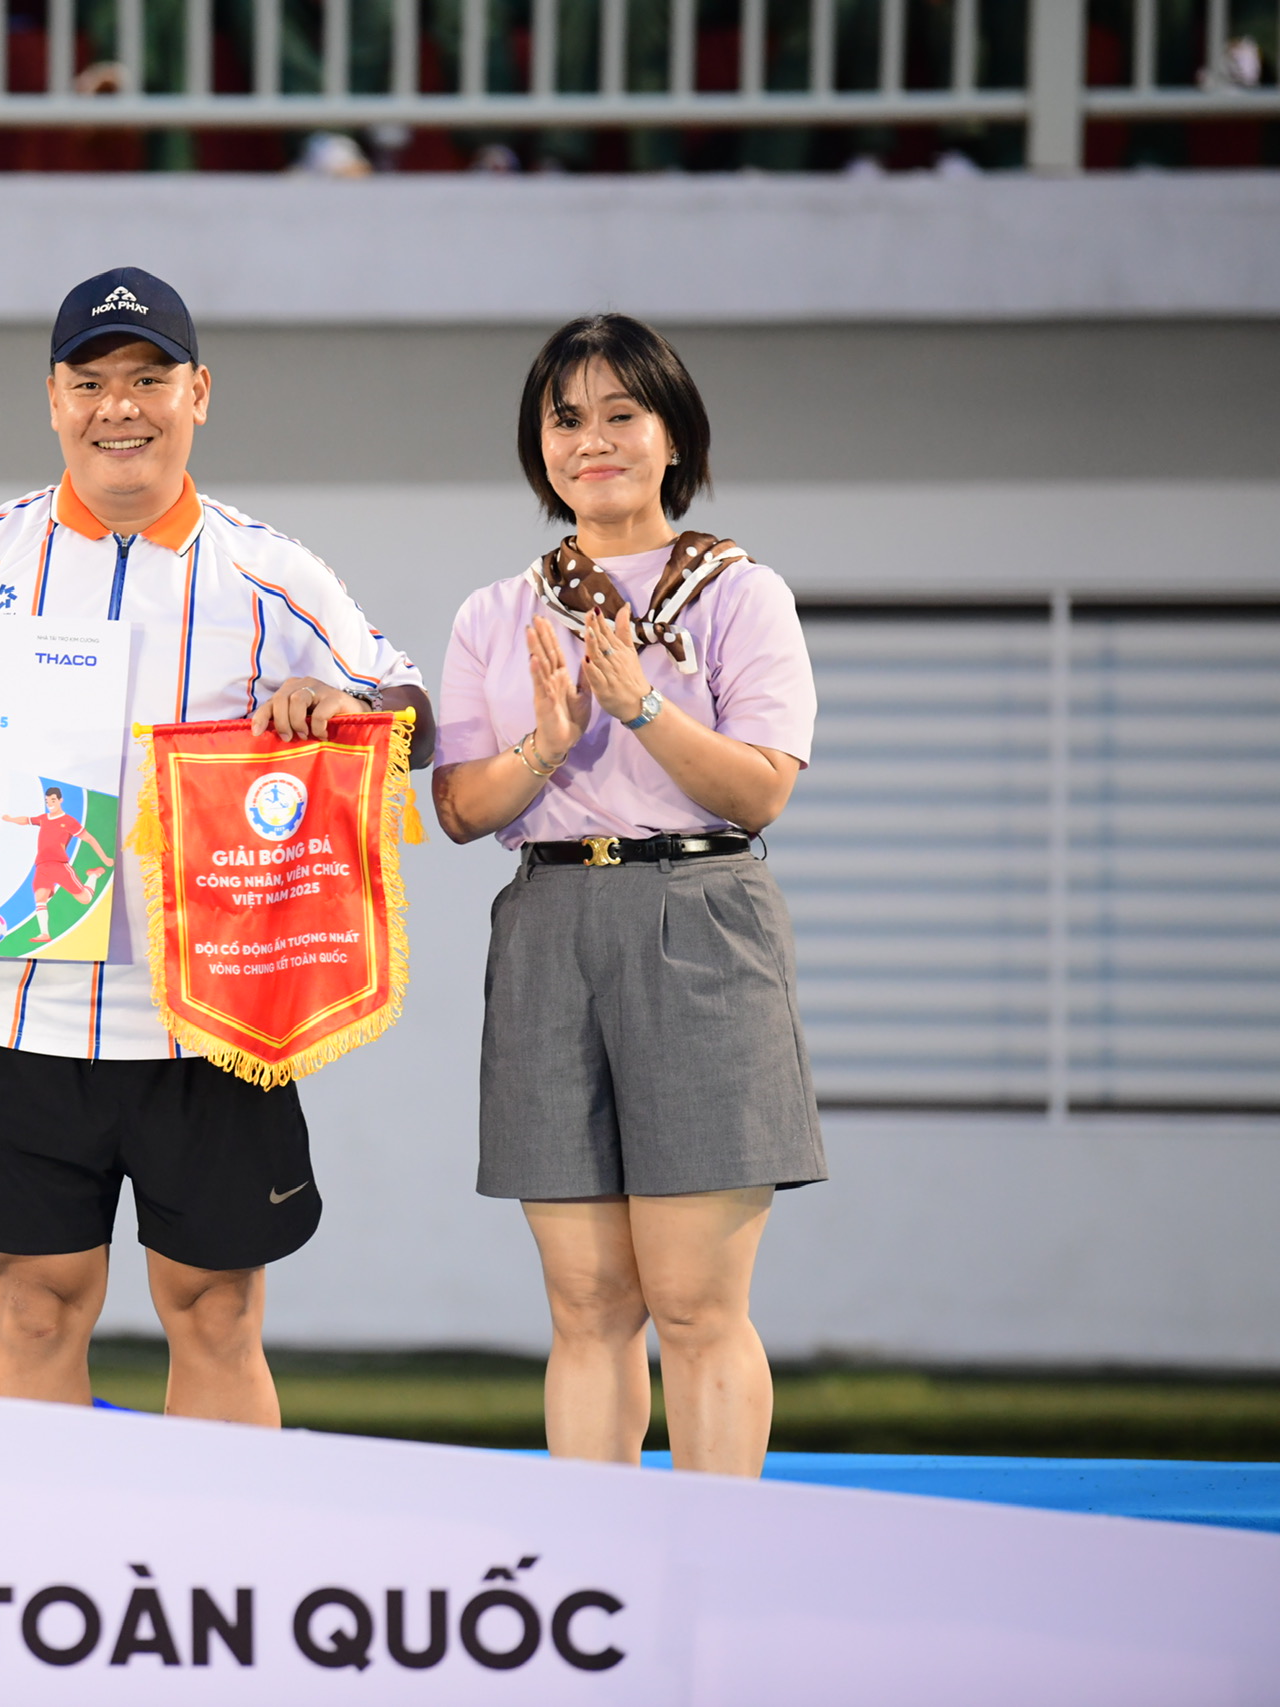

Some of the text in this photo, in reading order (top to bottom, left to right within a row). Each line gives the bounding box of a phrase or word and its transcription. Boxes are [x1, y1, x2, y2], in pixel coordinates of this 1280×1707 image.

[34, 652, 98, 667] THACO
[212, 834, 333, 866] GIẢI BÓNG ĐÁ
[196, 861, 350, 888] CÔNG NHÂN, VIÊN CHỨC
[232, 882, 320, 909] VIỆT NAM 2025
[194, 942, 218, 958] ĐỘI
[242, 942, 272, 958] ĐỘNG
[274, 937, 286, 952] ẤN
[288, 932, 328, 948] TƯỢNG
[329, 930, 360, 943] NHẤT
[208, 948, 348, 975] VÒNG CHUNG KẾT TOÀN QUỐC
[291, 1555, 628, 1673] QUỐC
